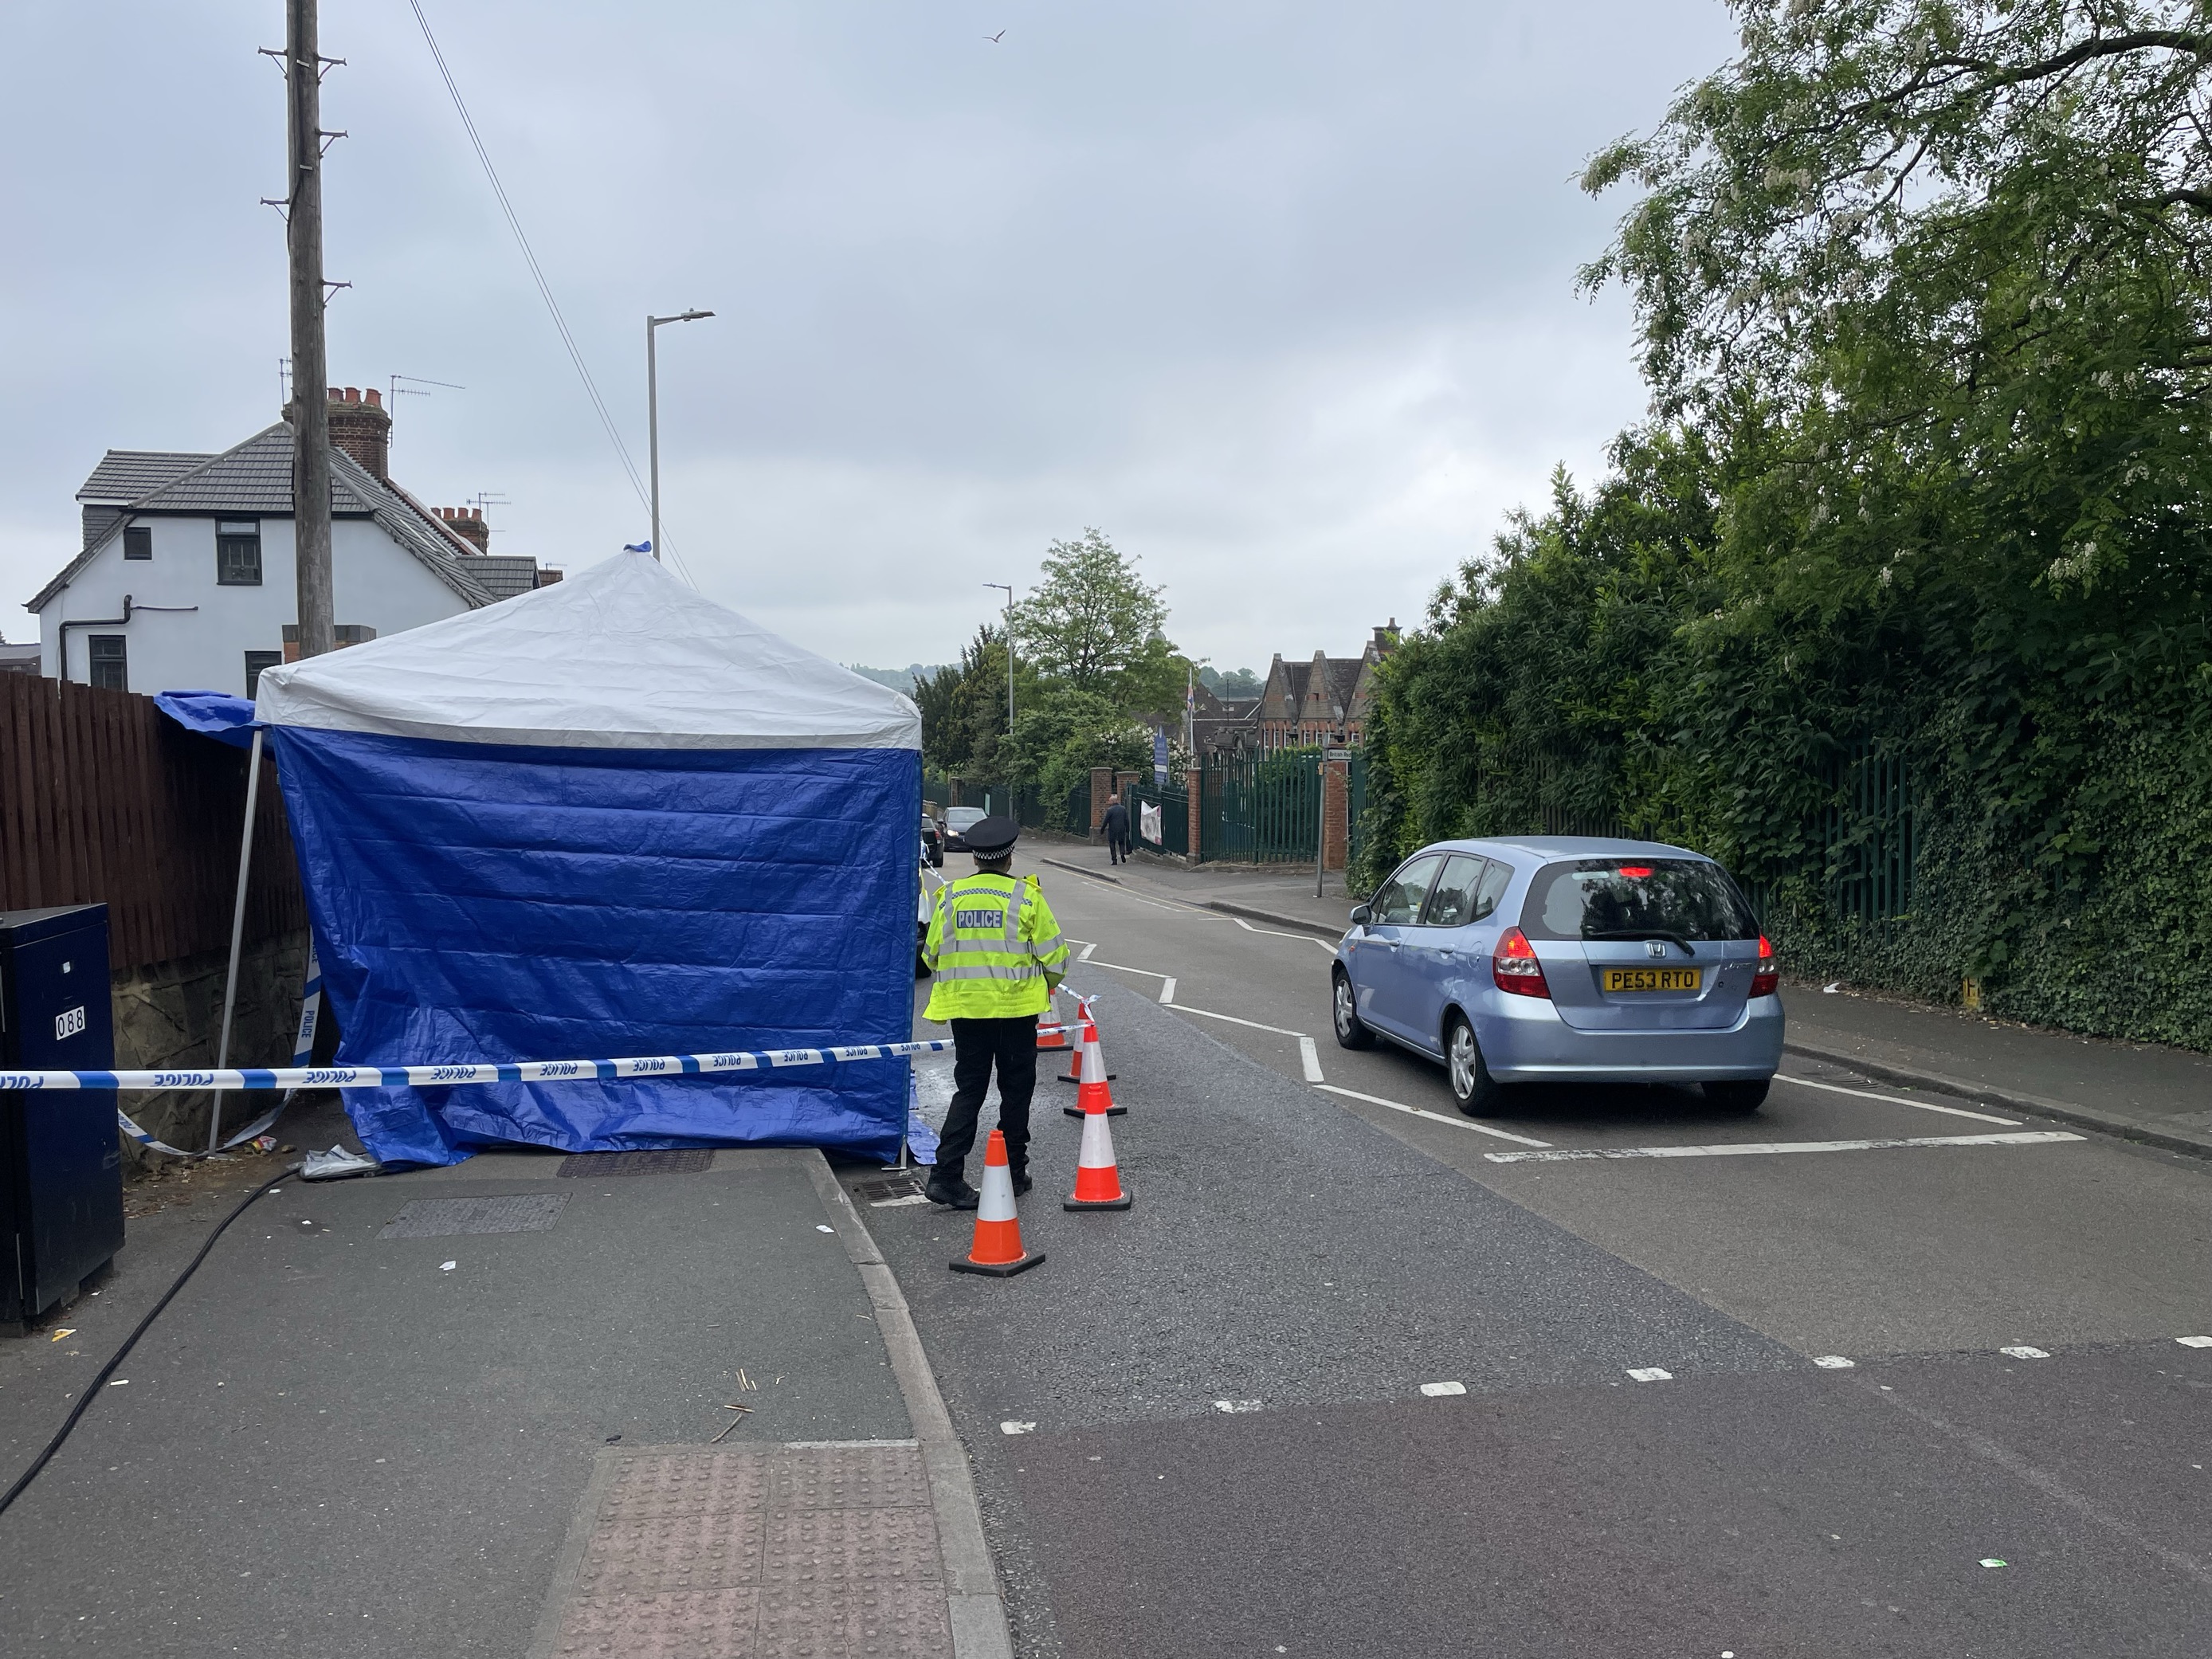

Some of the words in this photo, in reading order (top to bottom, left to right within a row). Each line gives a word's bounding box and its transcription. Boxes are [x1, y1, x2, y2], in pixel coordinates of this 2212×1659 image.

[958, 911, 1001, 928] POLICE
[1611, 971, 1657, 989] PE53
[1661, 971, 1694, 988] RTO
[57, 1009, 83, 1037] 088
[301, 1010, 316, 1038] POLICE
[783, 1050, 809, 1062] POLICE
[846, 1045, 869, 1057] POLICE
[633, 1057, 665, 1072] POLICE
[713, 1054, 742, 1068] POLICE
[302, 1070, 357, 1084] POLICE
[429, 1065, 477, 1080] POLICE
[539, 1062, 578, 1077] POLICE
[149, 1073, 214, 1087] POLICE
